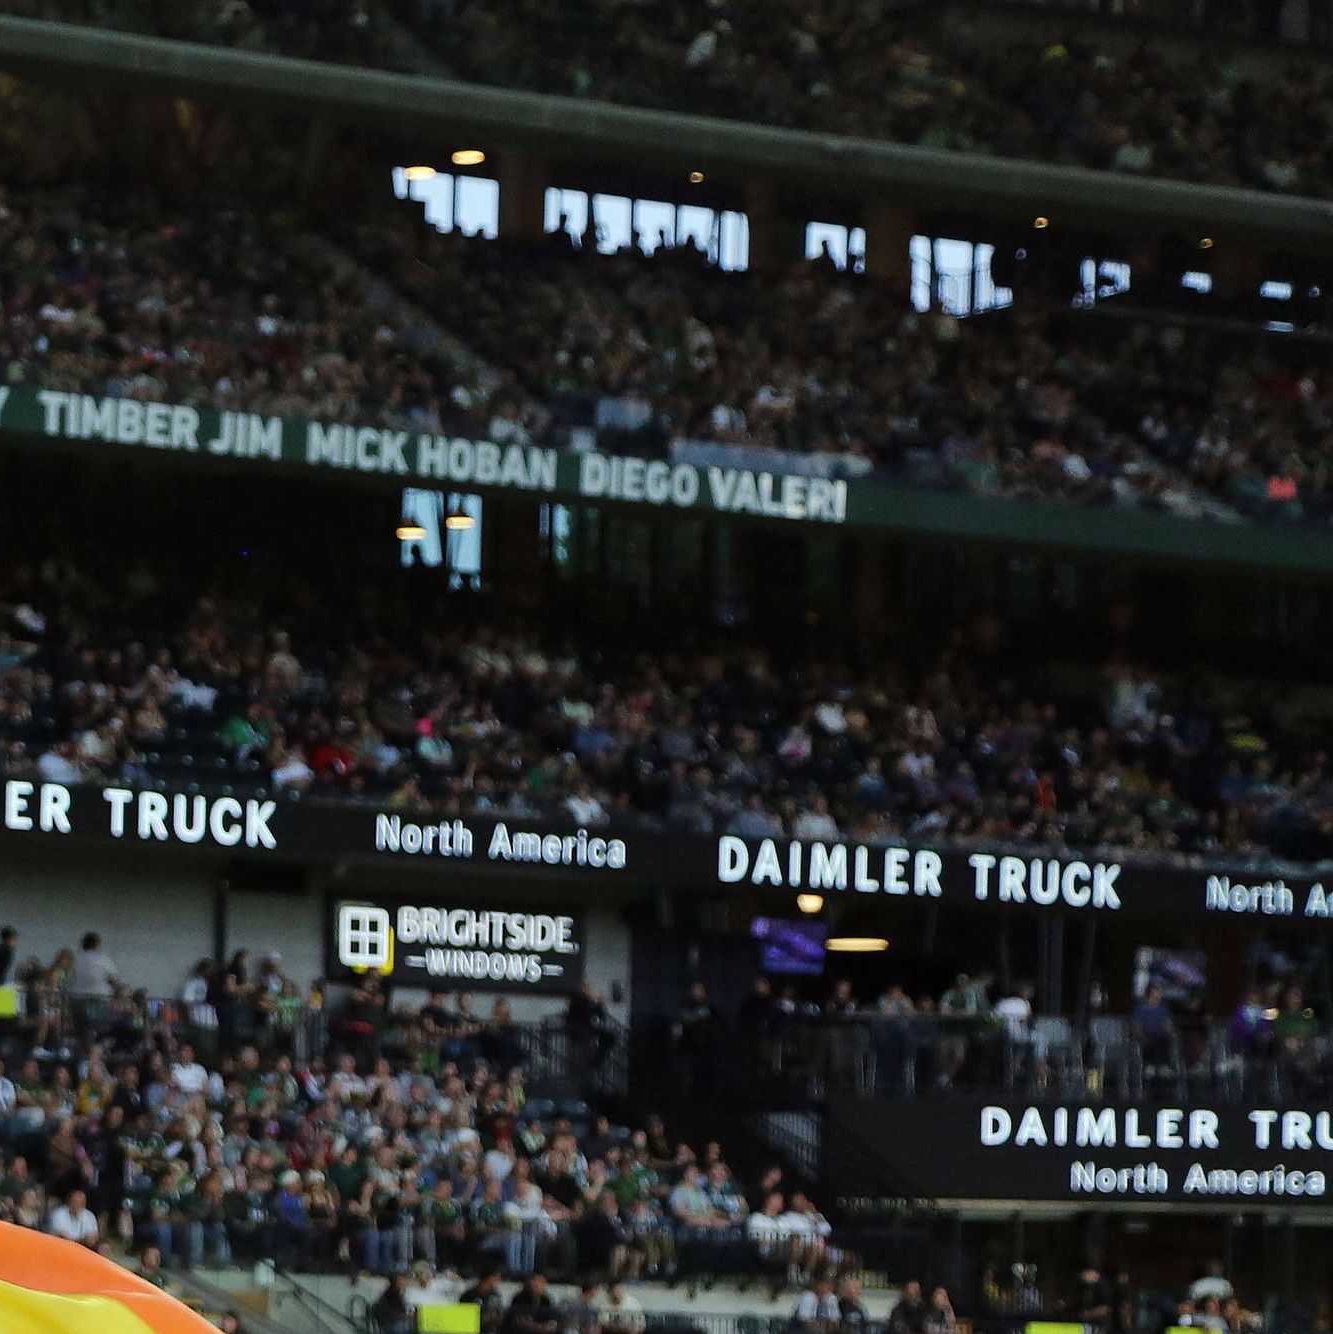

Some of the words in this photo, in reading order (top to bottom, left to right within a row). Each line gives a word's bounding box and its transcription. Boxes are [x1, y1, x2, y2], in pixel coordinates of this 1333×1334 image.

[38, 388, 200, 452] TIMBER
[208, 414, 282, 459] JIM
[306, 424, 409, 474] MICK
[417, 434, 558, 492] HOBAN
[580, 455, 700, 508] DIEGO
[709, 470, 848, 523] VALERI
[102, 788, 278, 850] TRUCK
[375, 813, 474, 858] North
[487, 822, 628, 869] America
[718, 836, 943, 896] DAIMLER
[968, 854, 1123, 910] TRUCK
[1205, 875, 1295, 916] North
[425, 949, 542, 983] WINDOWS
[980, 1106, 1220, 1149] DAIMLER
[1070, 1160, 1169, 1195] North
[1183, 1163, 1327, 1198] America
